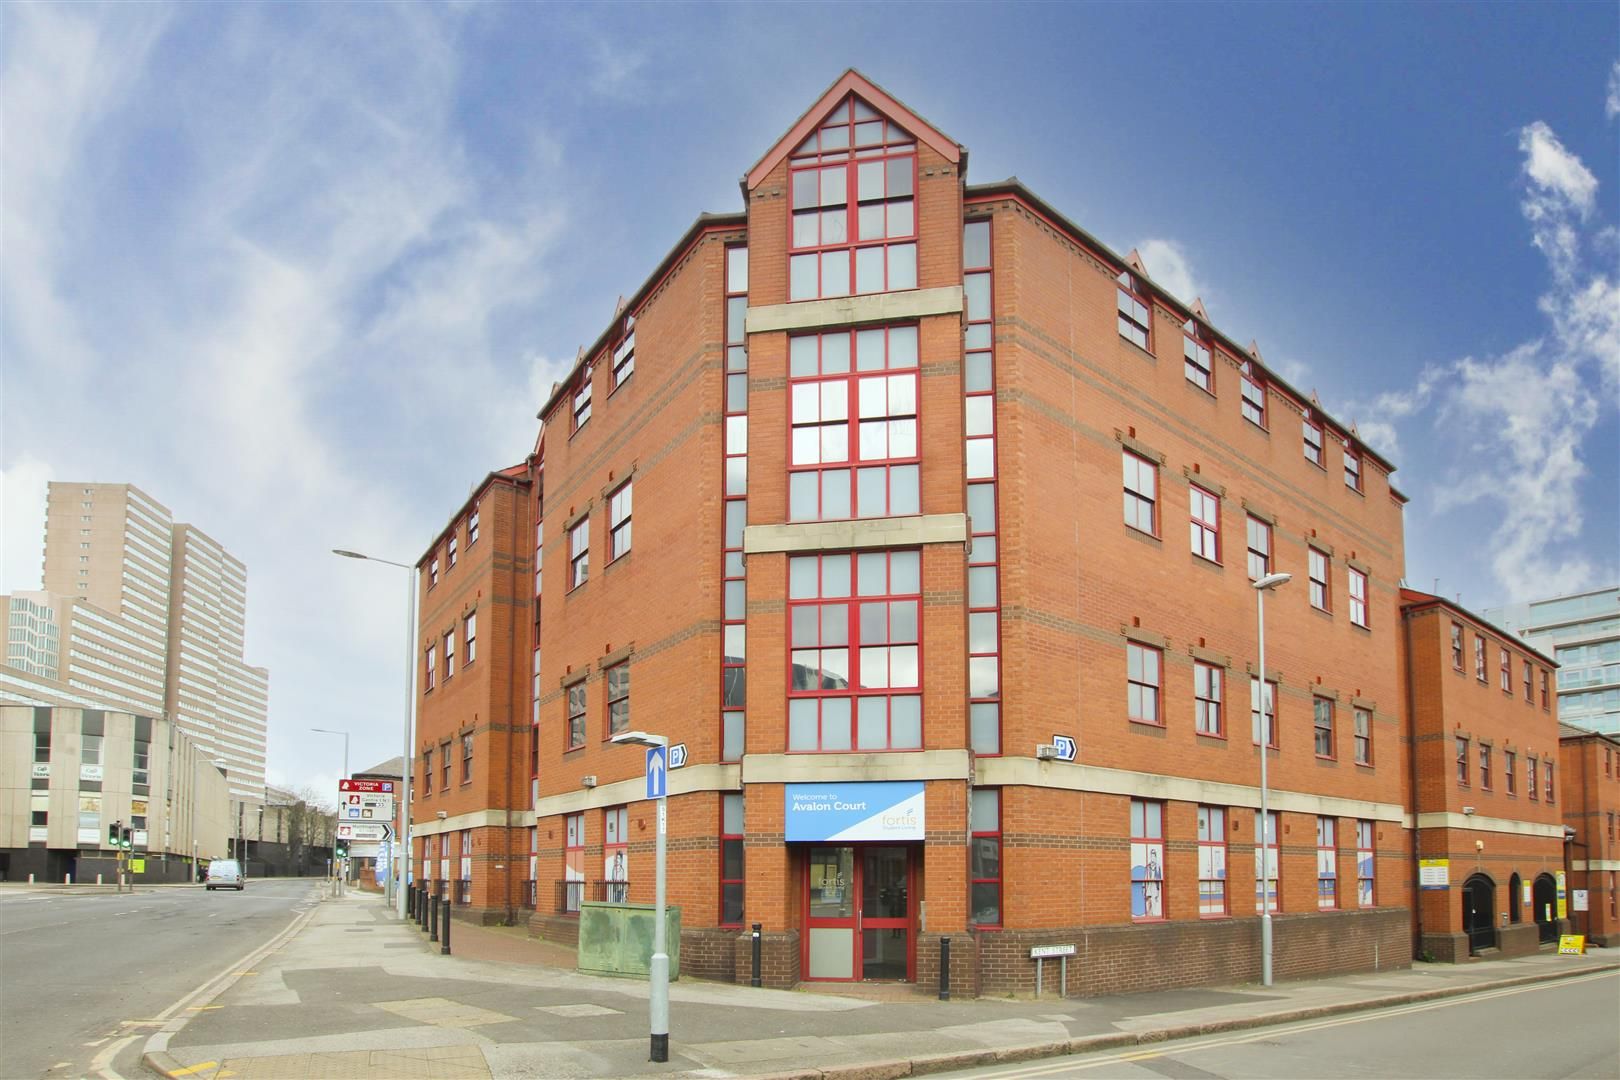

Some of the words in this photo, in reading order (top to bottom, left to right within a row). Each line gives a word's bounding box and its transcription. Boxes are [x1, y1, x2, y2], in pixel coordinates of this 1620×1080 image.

[792, 793, 827, 801] Welcome
[792, 802, 831, 811] Avalon
[833, 802, 867, 811] Court
[882, 814, 917, 826] fortis
[818, 878, 845, 886] fortis
